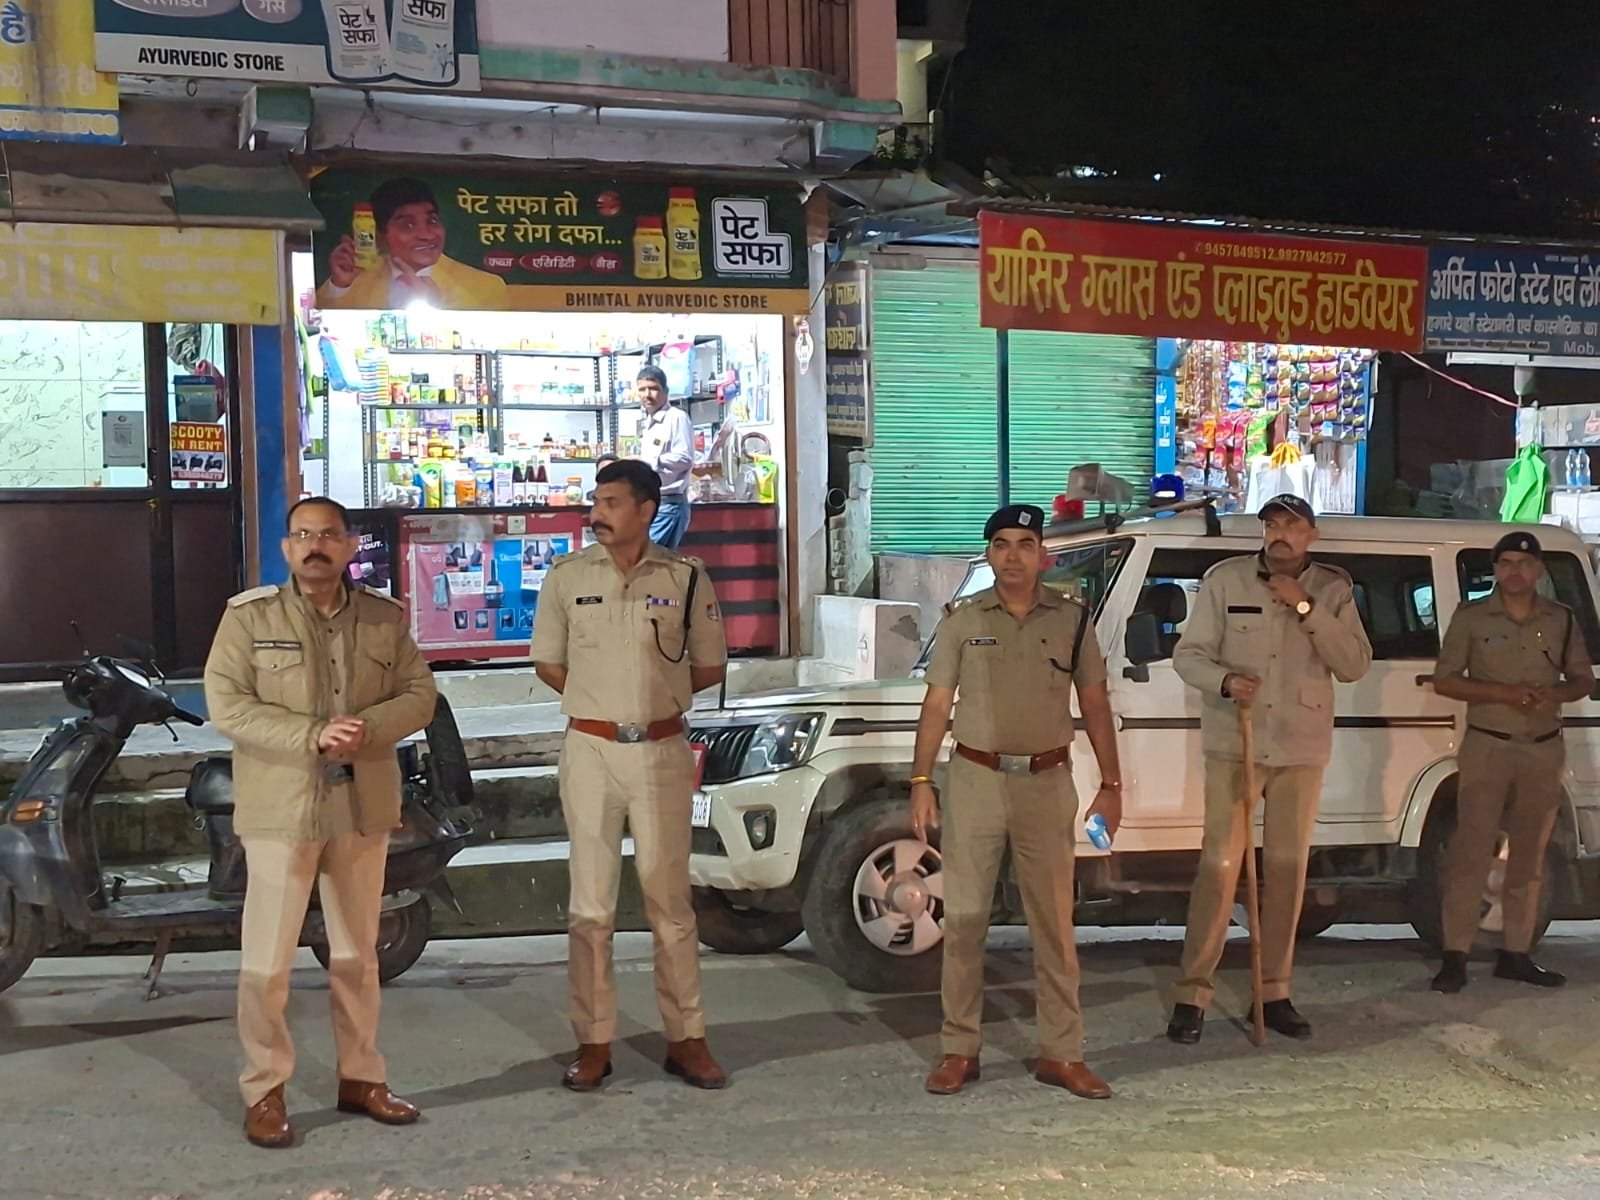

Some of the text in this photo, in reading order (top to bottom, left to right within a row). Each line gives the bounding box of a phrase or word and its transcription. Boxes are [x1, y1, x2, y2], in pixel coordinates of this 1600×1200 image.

[339, 7, 362, 28] पेट
[342, 29, 376, 44] सफा
[138, 47, 285, 71] AYURVEDIC STORE
[457, 187, 579, 216] पेट सफा तो
[478, 223, 507, 245] हर
[513, 217, 552, 244] रोग
[720, 205, 759, 240] पेट
[721, 241, 784, 266] सफा
[986, 227, 1074, 314] यासिर
[1081, 254, 1158, 321] ग्लास
[1165, 251, 1205, 319] एंड
[1430, 255, 1477, 301] अर्पित
[1480, 258, 1517, 304] फोटो
[1520, 261, 1551, 305] स्टेट
[1553, 263, 1580, 307] एवं
[565, 292, 768, 309] BHIMTAL AYURVEDIC STORE
[171, 425, 222, 439] SCOOTY
[171, 439, 223, 451] ON RENT
